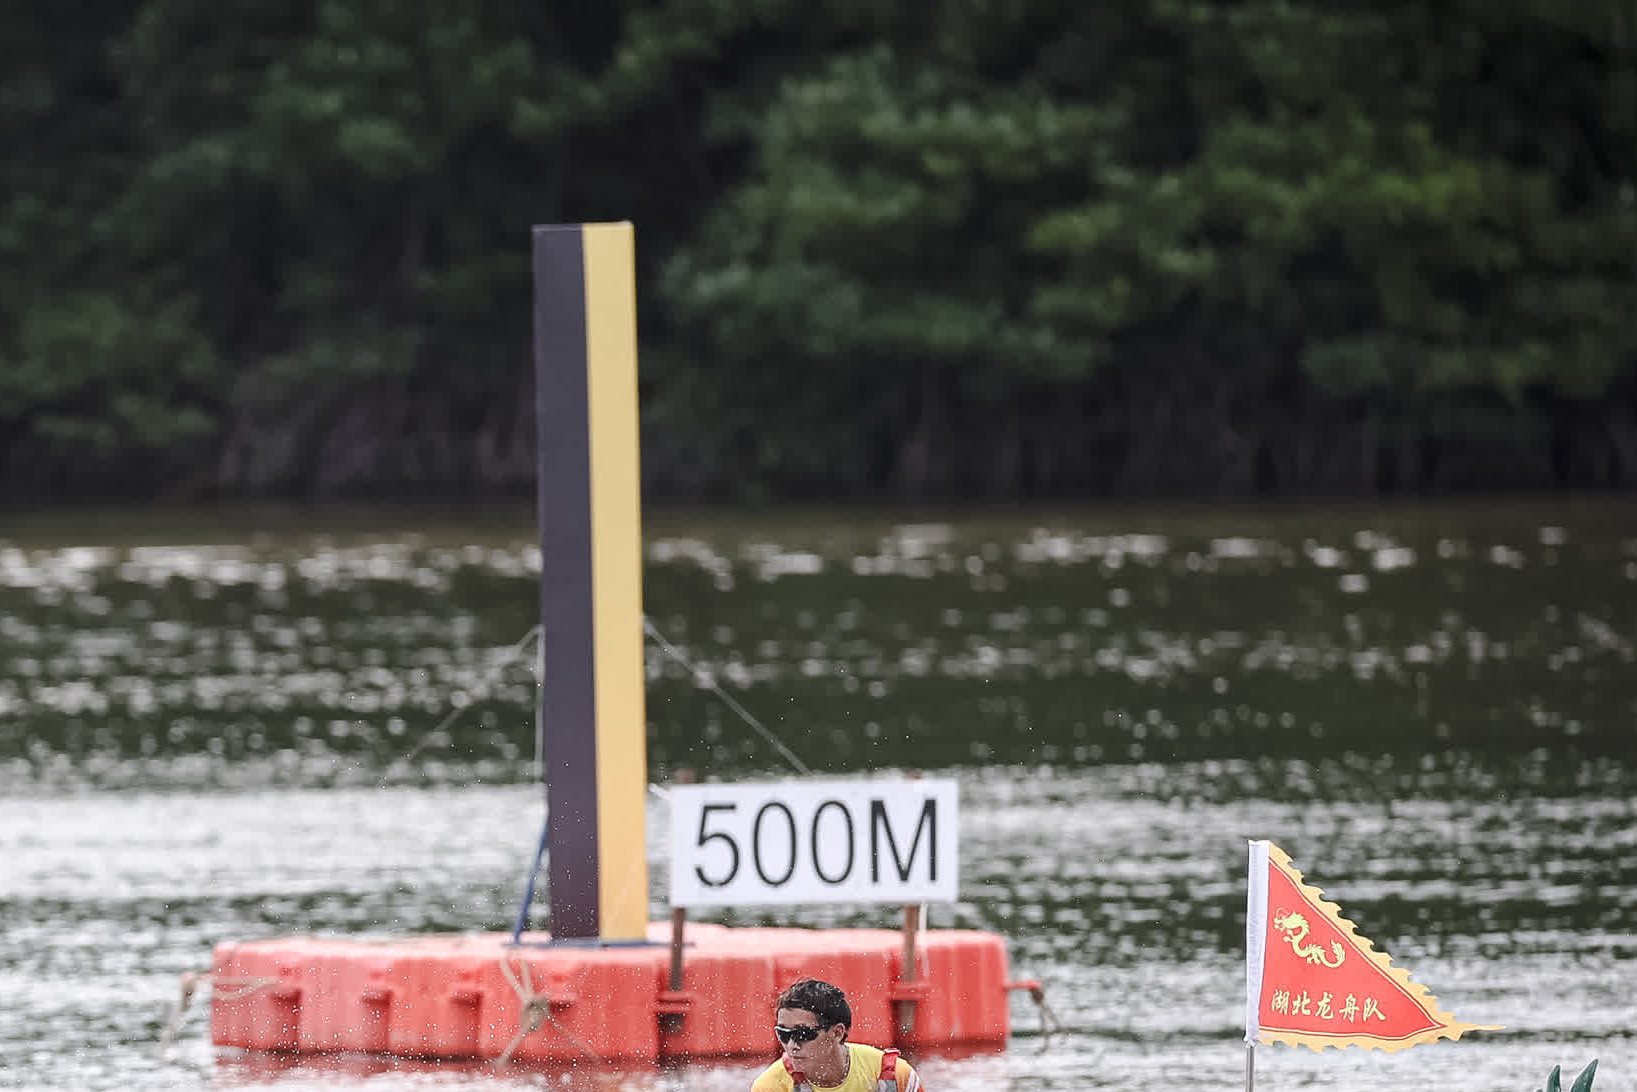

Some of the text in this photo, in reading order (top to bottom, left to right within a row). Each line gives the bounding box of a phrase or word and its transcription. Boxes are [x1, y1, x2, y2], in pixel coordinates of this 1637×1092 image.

[695, 799, 937, 887] 500M
[1271, 988, 1387, 1023] 湖北龙舟队
